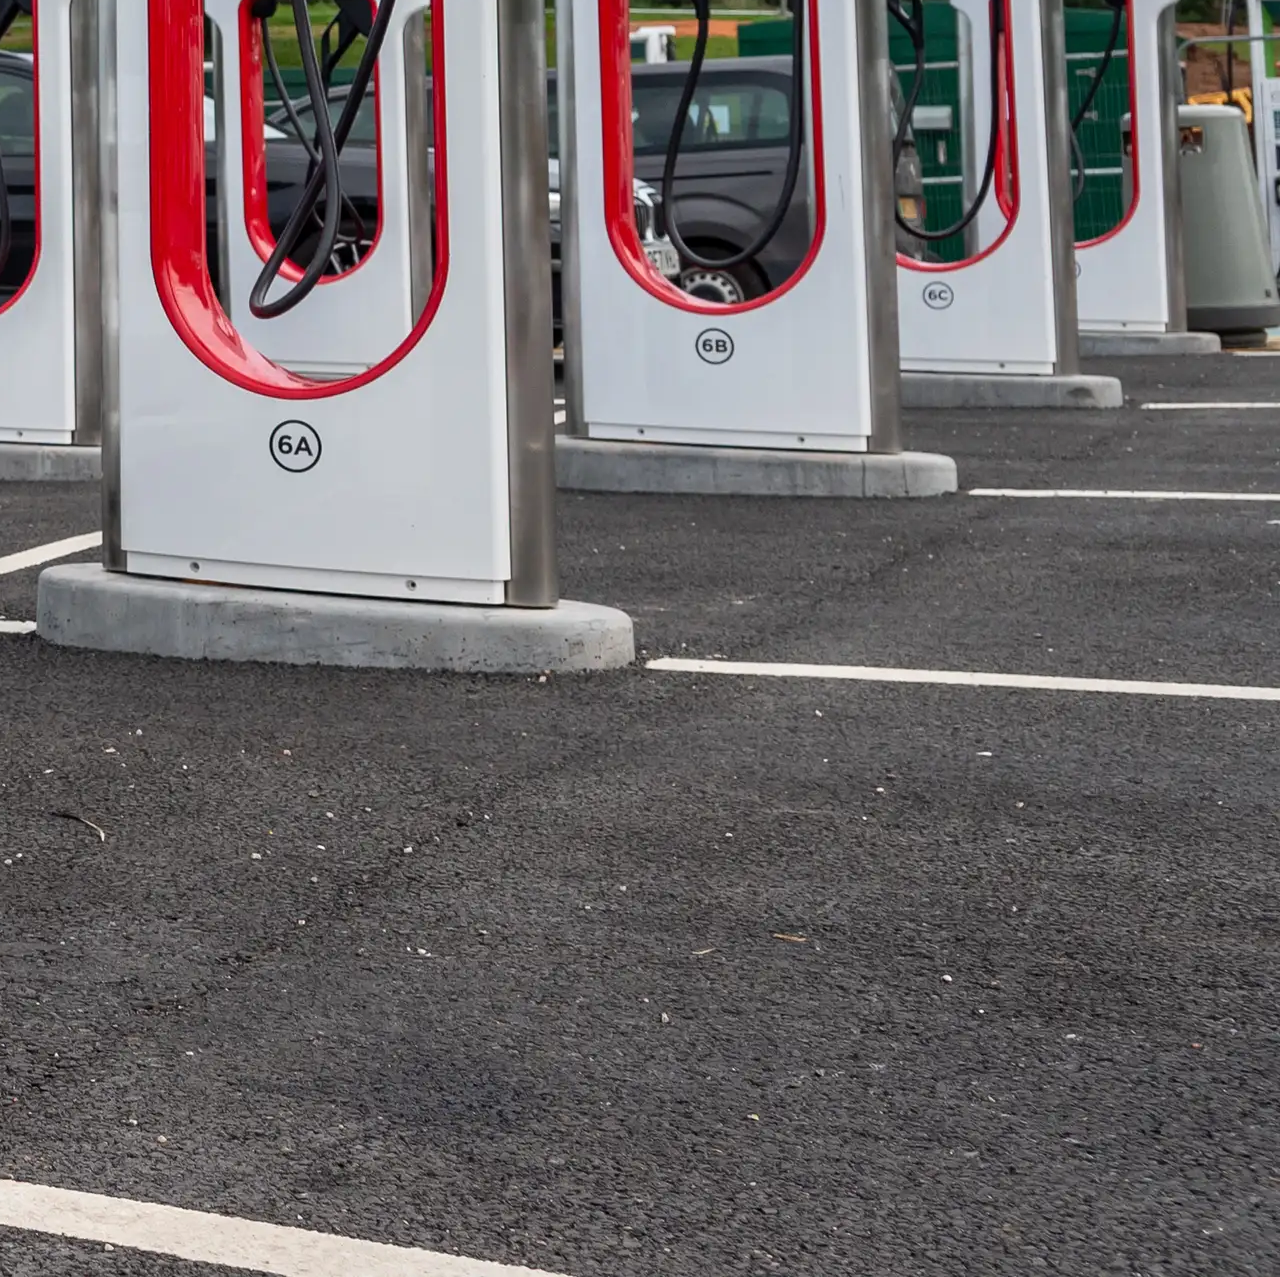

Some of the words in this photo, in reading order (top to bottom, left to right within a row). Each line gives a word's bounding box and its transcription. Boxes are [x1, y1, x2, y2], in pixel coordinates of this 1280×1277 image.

[928, 289, 948, 301] 6C
[702, 338, 728, 353] 6B
[278, 434, 314, 457] 6A
